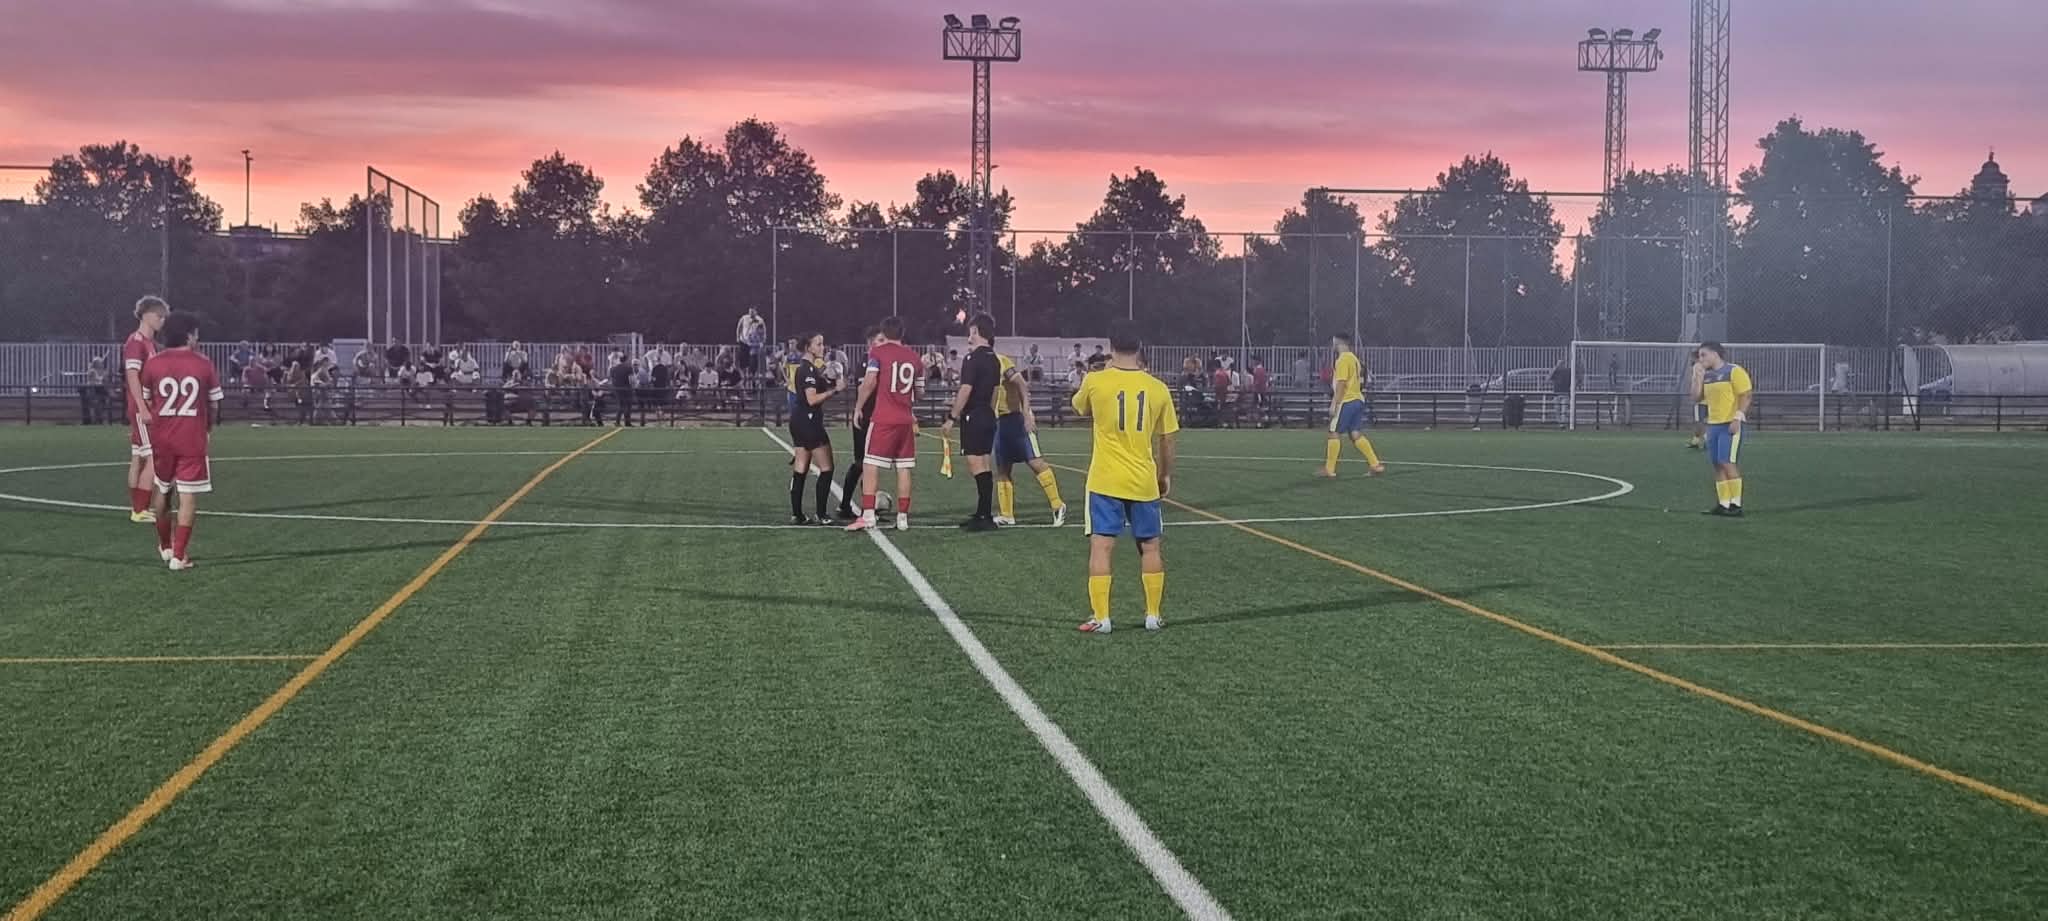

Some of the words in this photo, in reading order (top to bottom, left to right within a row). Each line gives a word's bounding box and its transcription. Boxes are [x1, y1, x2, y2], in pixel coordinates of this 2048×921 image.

[159, 376, 199, 416] 22
[891, 361, 915, 394] 19
[1117, 390, 1145, 431] 11
